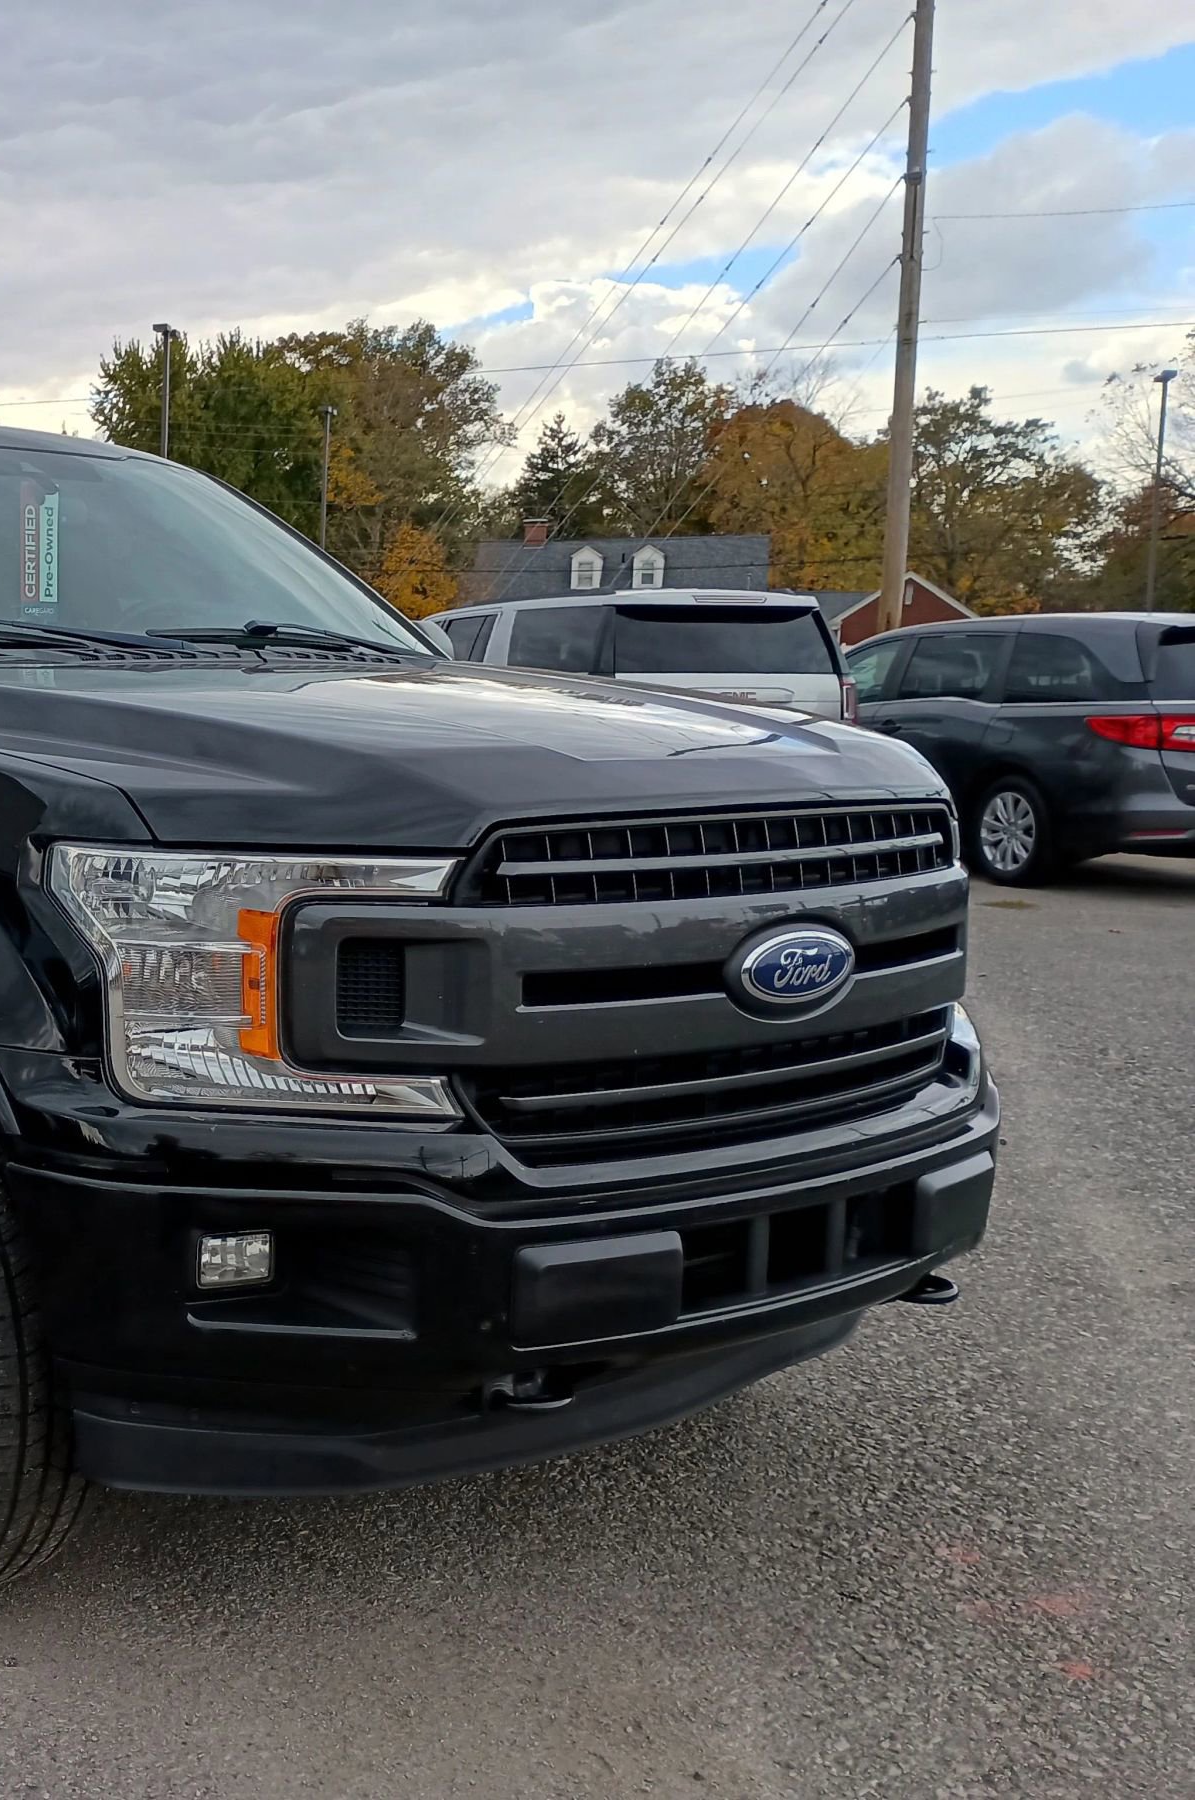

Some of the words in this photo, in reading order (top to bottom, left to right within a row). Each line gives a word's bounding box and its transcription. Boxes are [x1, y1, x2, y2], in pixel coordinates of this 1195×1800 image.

[24, 504, 37, 598] CERTIFIED
[44, 506, 54, 598] Pre-Owned
[773, 947, 833, 989] Ford
